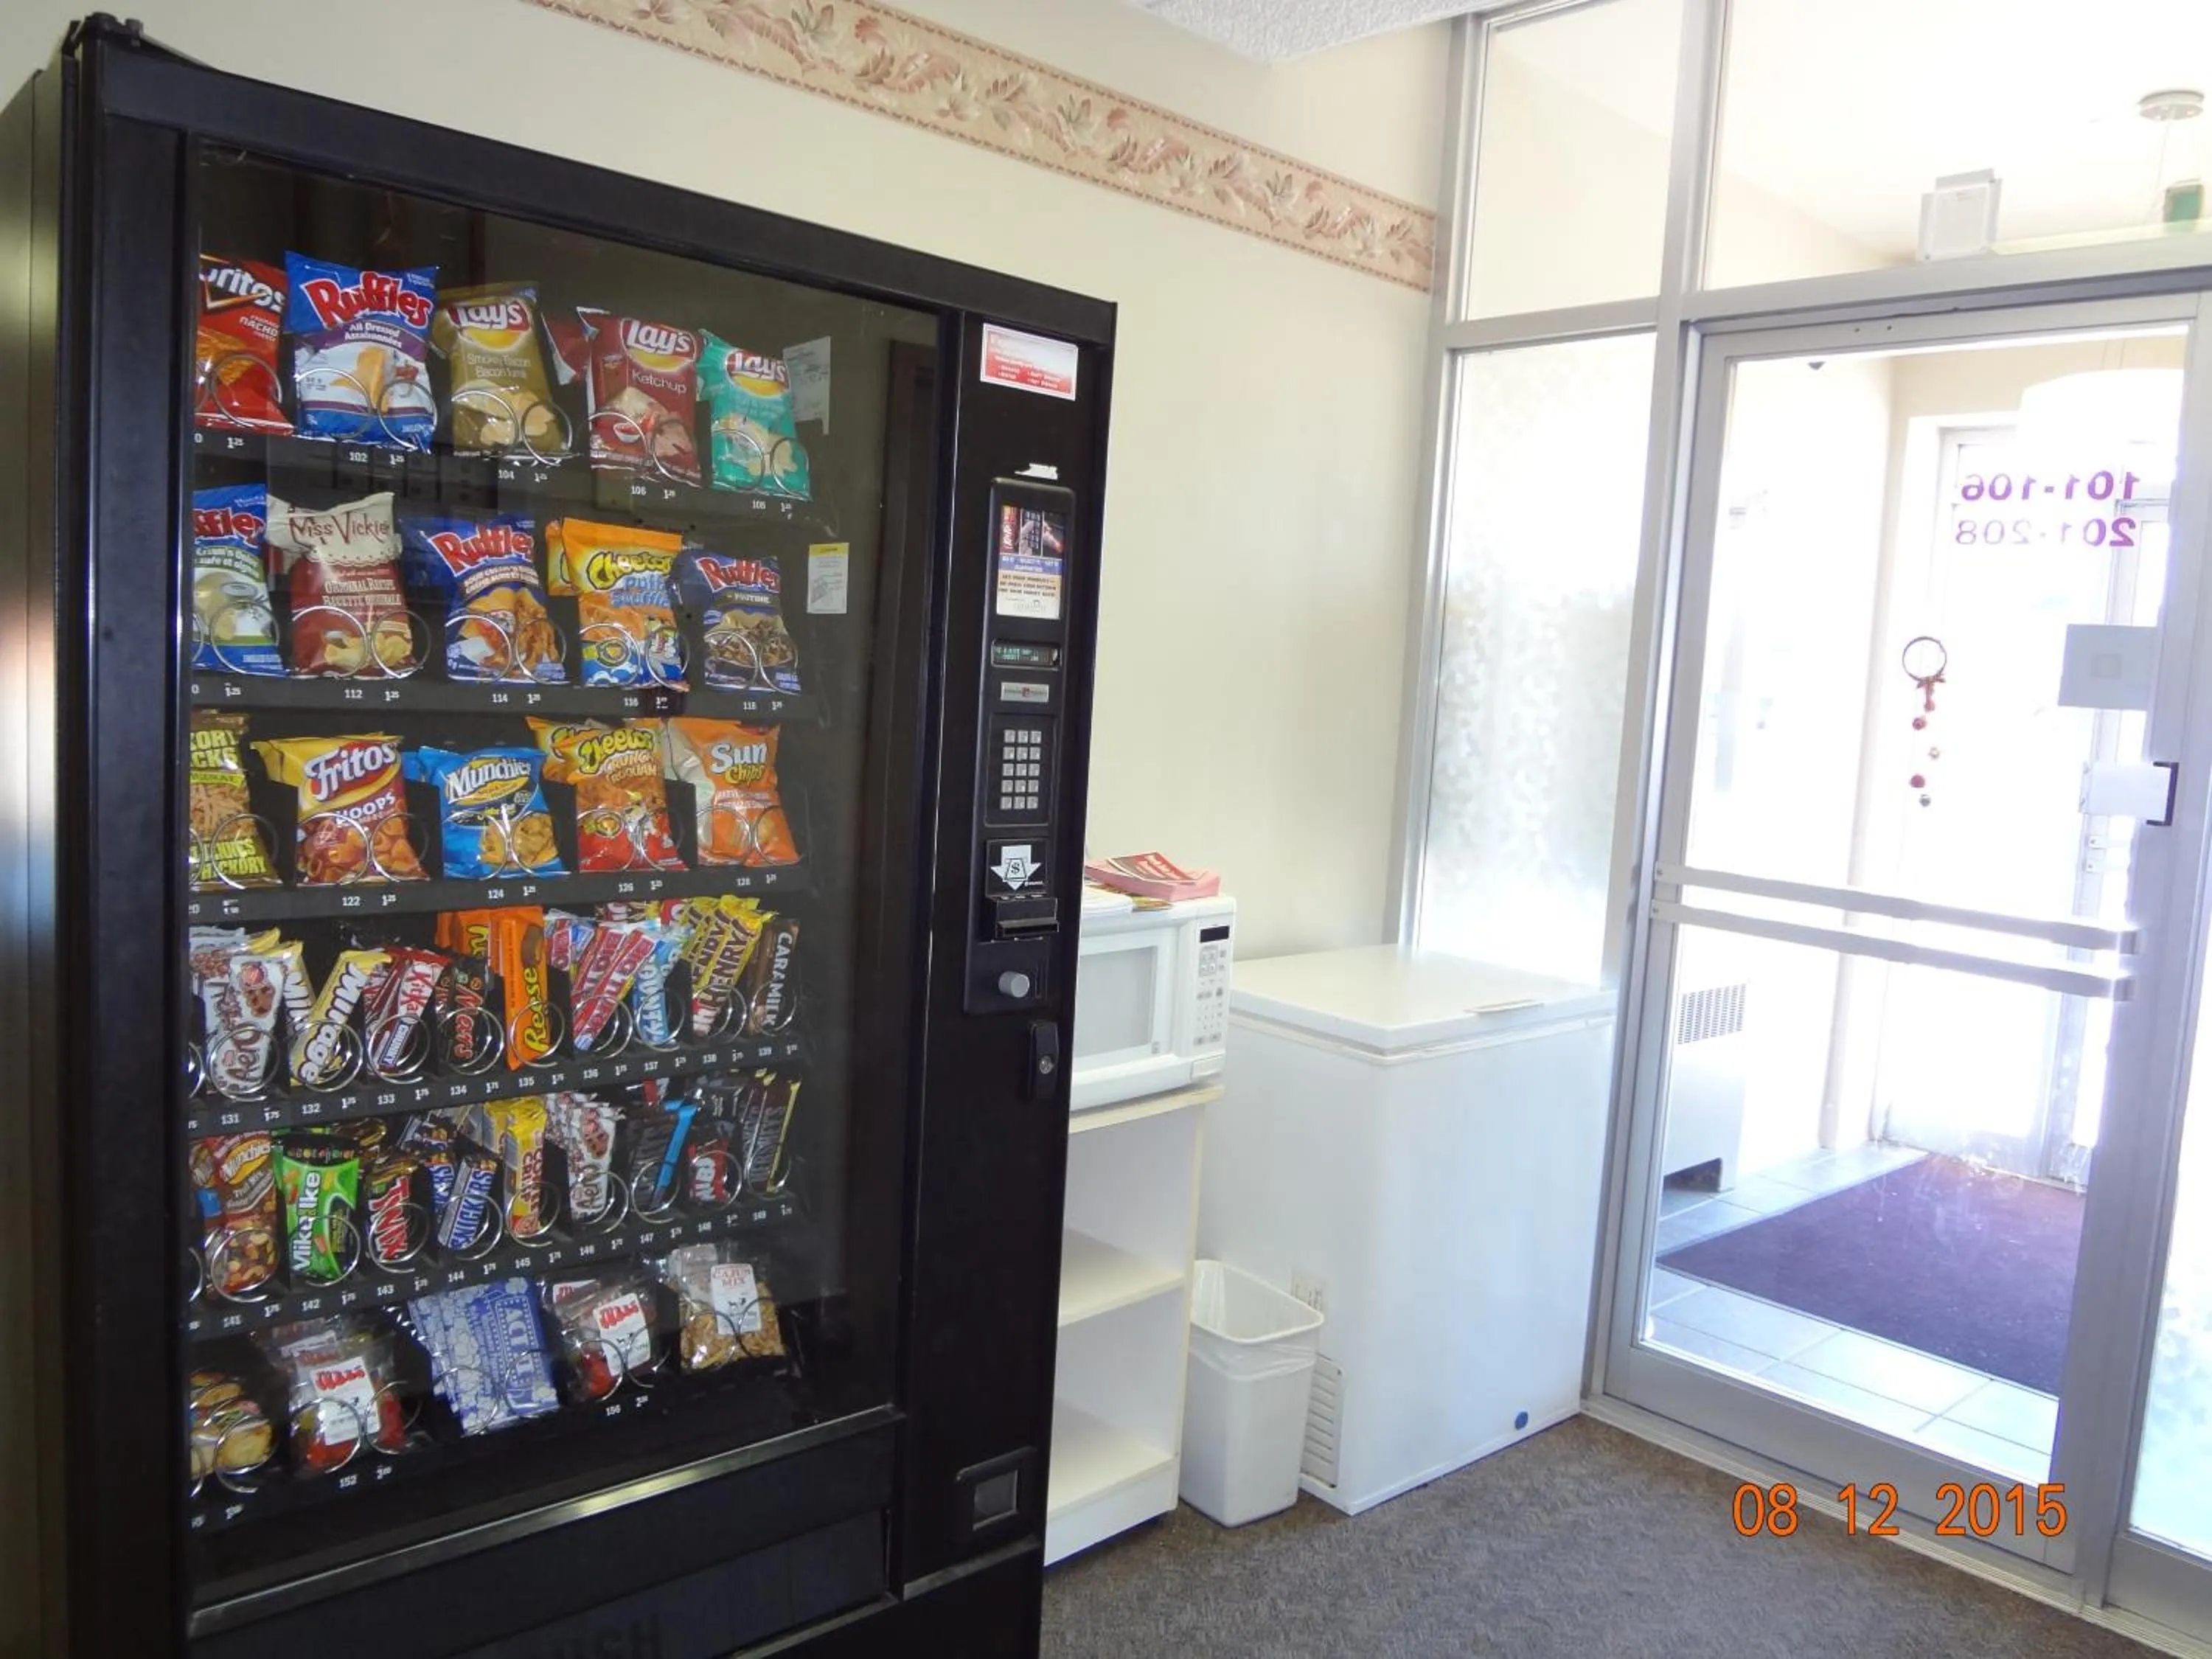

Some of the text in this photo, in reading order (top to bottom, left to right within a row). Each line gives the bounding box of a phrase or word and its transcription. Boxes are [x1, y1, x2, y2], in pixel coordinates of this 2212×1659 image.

[199, 266, 286, 313] ritos
[302, 271, 434, 330] Ruffles
[239, 315, 279, 337] NACHO
[625, 319, 692, 355] Lay's
[632, 368, 686, 397] Ketchup
[349, 451, 368, 462] 102
[431, 525, 535, 577] Ruffles
[697, 556, 780, 594] Ruffles
[344, 689, 363, 699] 112
[492, 693, 508, 703] 114
[712, 742, 768, 773] Sun
[304, 743, 397, 801] Fritos
[447, 758, 532, 804] Munchies
[725, 764, 765, 785] Chips
[341, 896, 361, 906] 122
[487, 888, 504, 900] 124
[762, 931, 794, 1026] CARAMILK
[522, 967, 550, 1052] Reese
[296, 962, 372, 1084] Mirage
[453, 984, 483, 1060] Mars
[644, 1061, 658, 1071] 137
[450, 1085, 467, 1096] 134
[518, 1076, 535, 1088] 135
[302, 1102, 321, 1115] 132
[377, 1093, 396, 1105] 133
[221, 1113, 240, 1125] 131
[369, 1175, 411, 1260] TWIX
[451, 1166, 493, 1250] SNICKRS
[293, 1170, 321, 1270] Mike Ike
[640, 1232, 654, 1244] 147
[448, 1270, 465, 1283] 144
[377, 1284, 394, 1296] 143
[302, 1298, 321, 1312] 142
